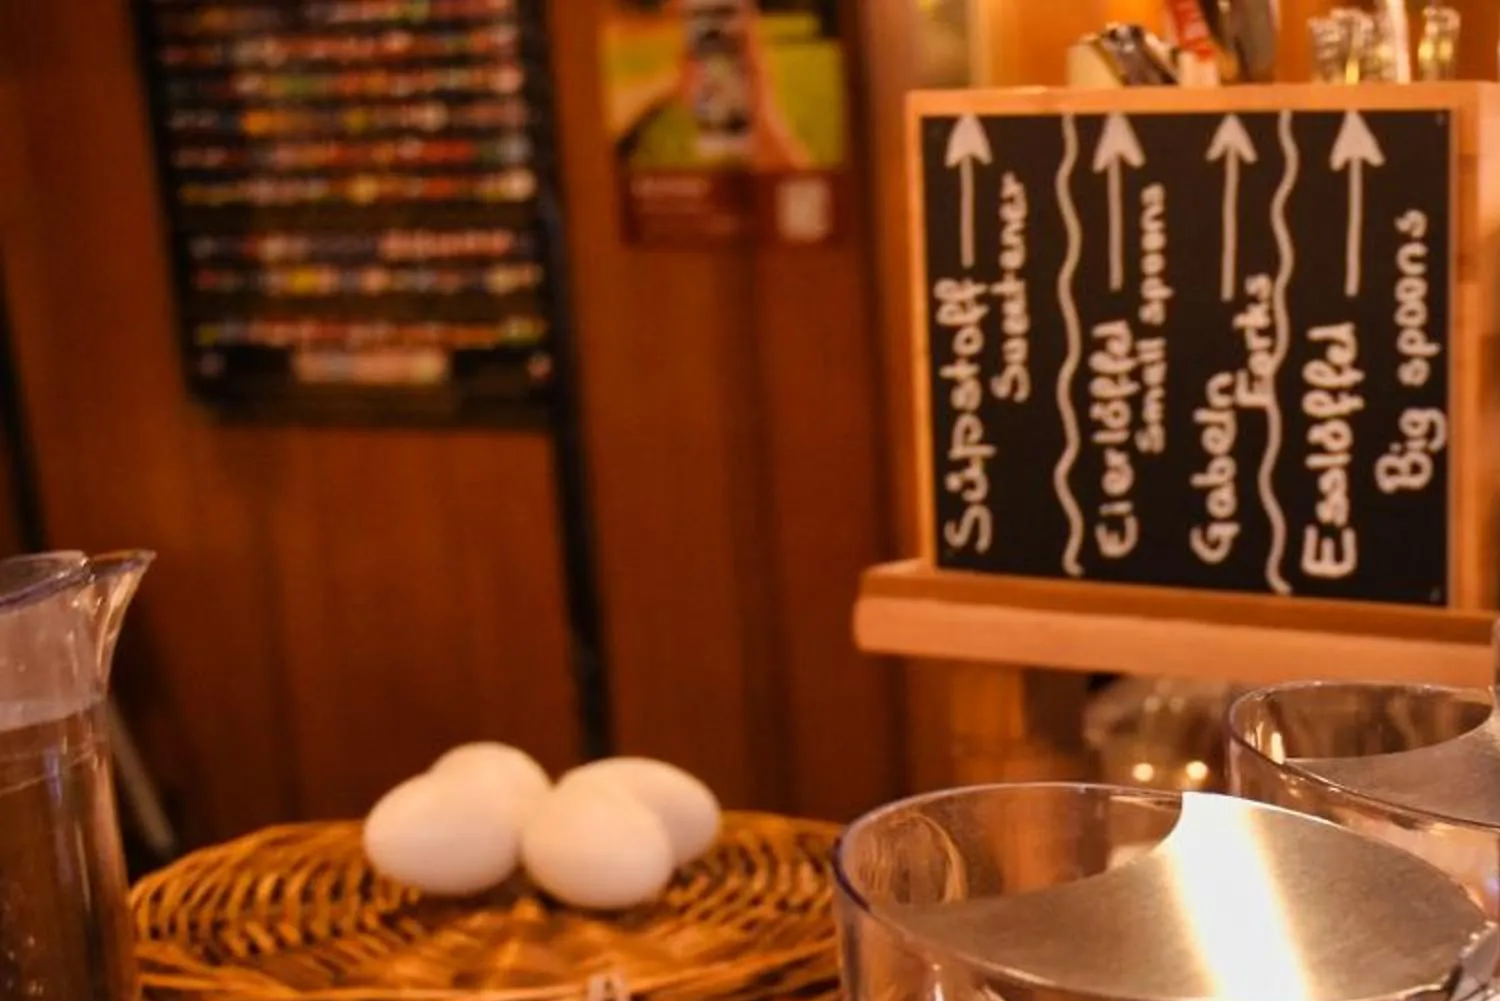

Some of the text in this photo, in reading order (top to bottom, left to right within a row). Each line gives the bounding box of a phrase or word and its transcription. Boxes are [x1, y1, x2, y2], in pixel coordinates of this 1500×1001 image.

[1135, 183, 1173, 453] Small spoons
[1232, 273, 1271, 407] Forks
[1375, 209, 1447, 493] Big spoons
[1190, 372, 1239, 563] Gabeln
[1303, 323, 1364, 578] Esslöffel
